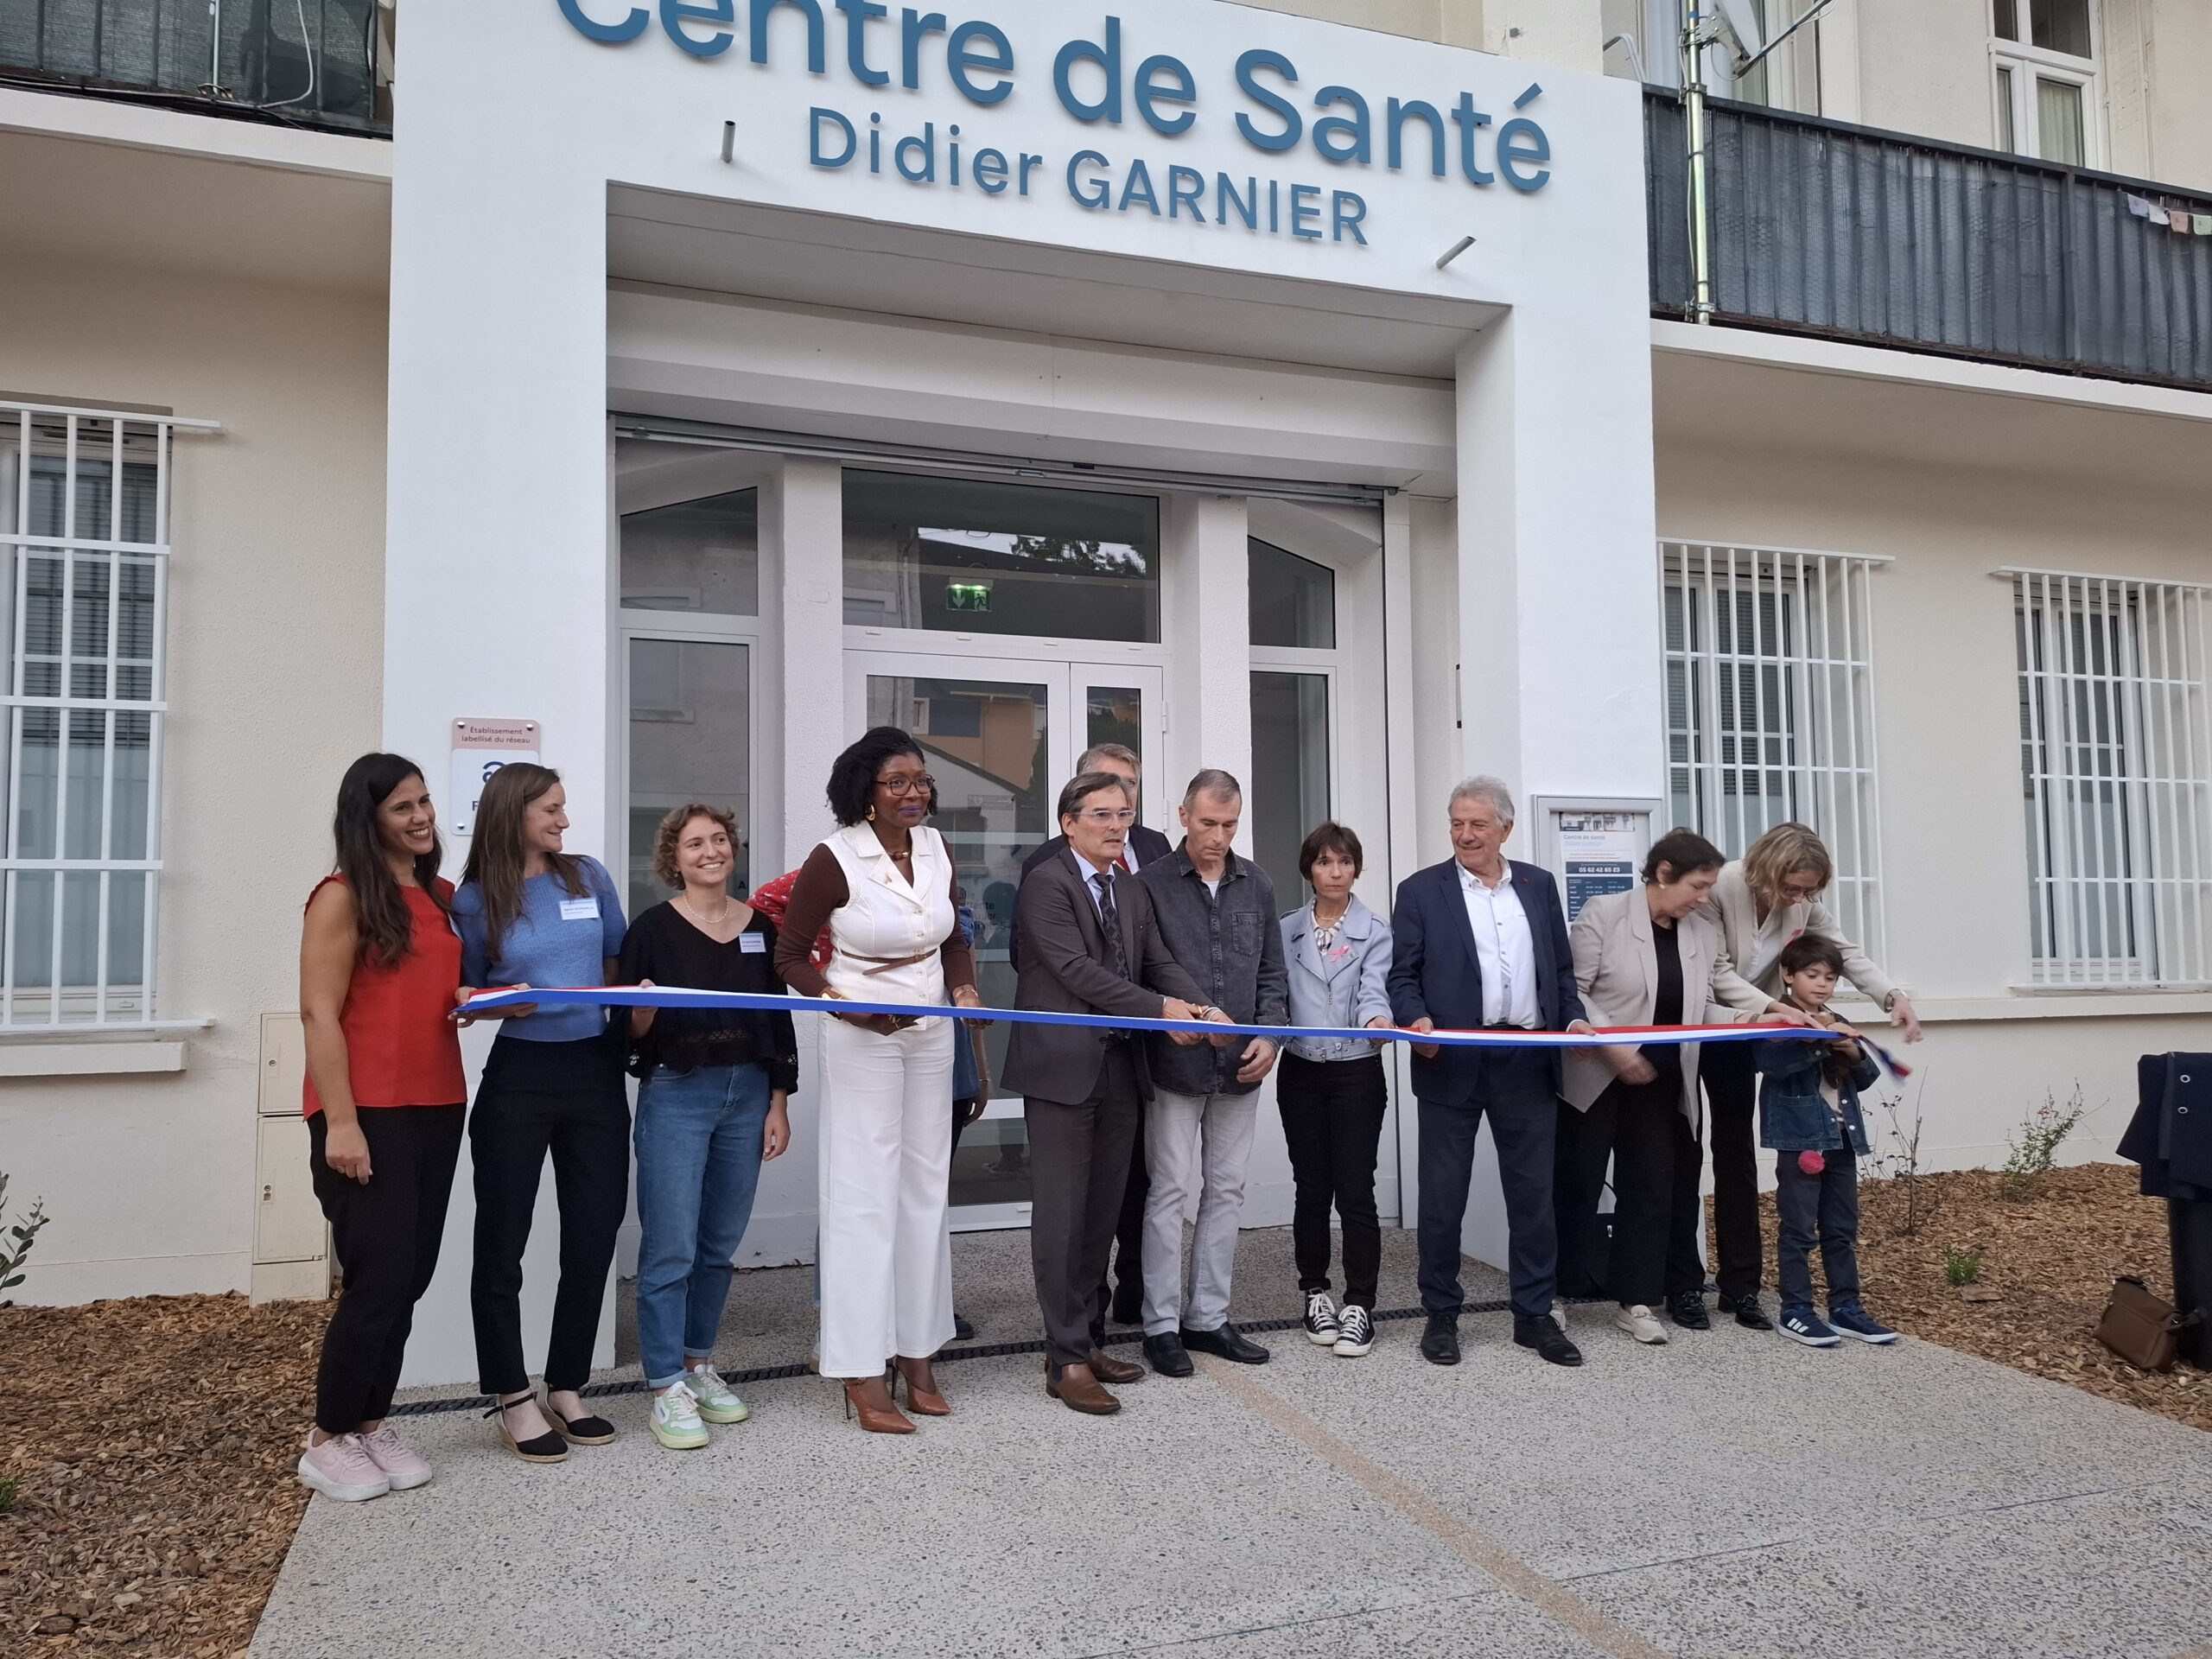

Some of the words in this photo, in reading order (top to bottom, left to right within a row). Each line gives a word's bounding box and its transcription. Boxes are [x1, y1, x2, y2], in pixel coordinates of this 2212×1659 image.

[1053, 16, 1197, 135] de
[1235, 49, 1551, 192] Santé
[810, 106, 1042, 195] Didier
[1066, 149, 1367, 245] GARNIER
[470, 726, 523, 734] Établissement
